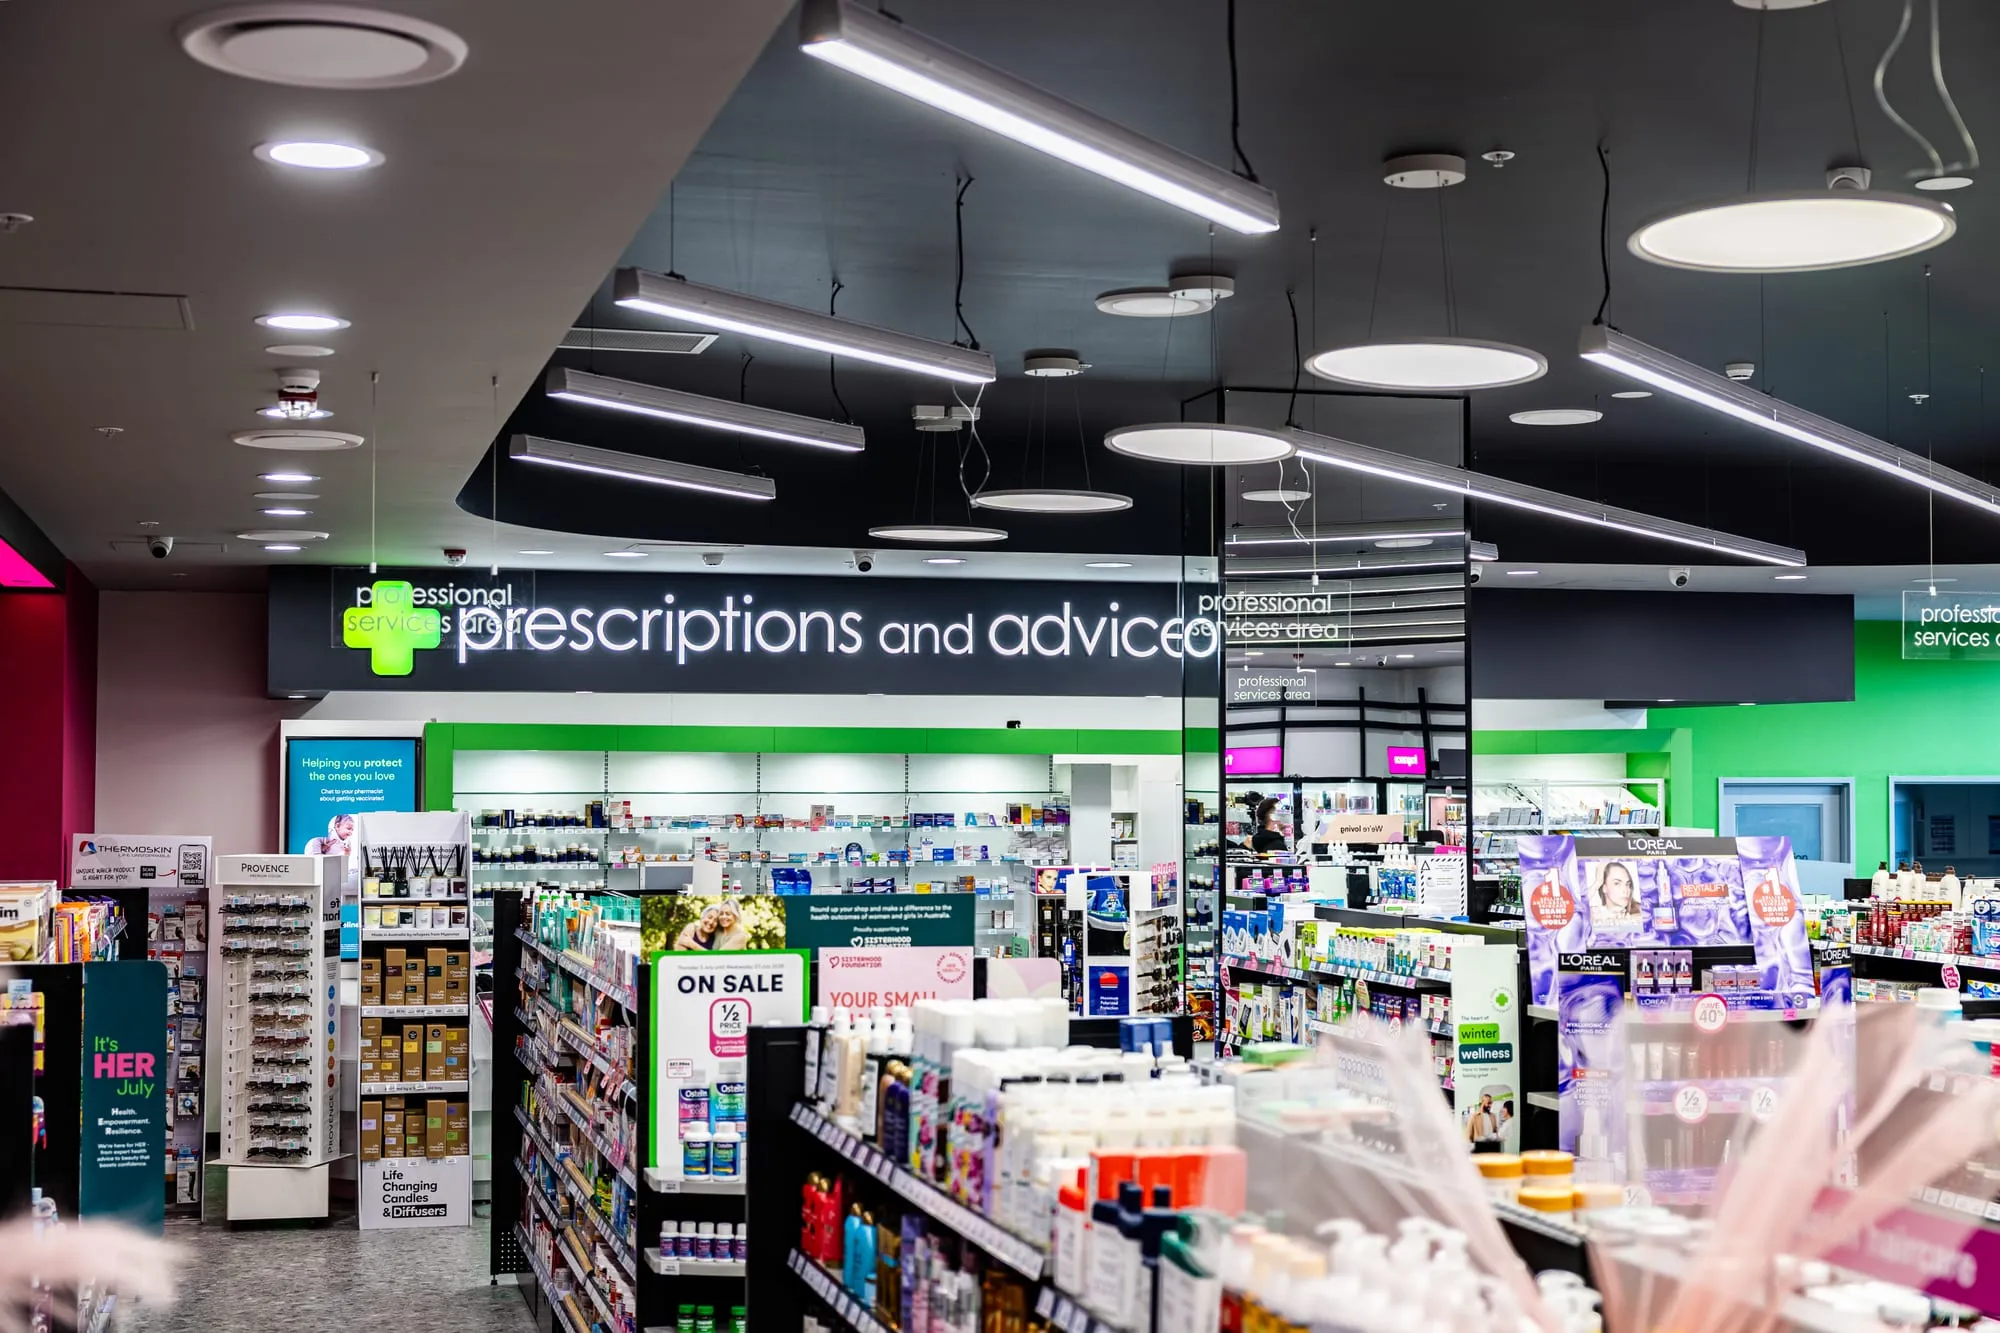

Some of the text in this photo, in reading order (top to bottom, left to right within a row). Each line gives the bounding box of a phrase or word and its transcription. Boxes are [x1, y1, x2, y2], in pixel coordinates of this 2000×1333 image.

[356, 581, 512, 607] professional
[1198, 590, 1332, 616] professional
[347, 611, 451, 633] services
[458, 594, 863, 665] prescriptions
[879, 613, 974, 655] and
[1191, 619, 1340, 639] services area
[1914, 627, 1990, 647] services
[1238, 674, 1307, 689] professional
[1234, 687, 1311, 701] services area
[302, 758, 402, 769] Helping you protect
[309, 772, 325, 781] the
[354, 774, 372, 782] you
[374, 772, 395, 781] love
[354, 788, 384, 796] pharmacist
[97, 845, 172, 854] THERMOSKIN
[1627, 837, 1683, 850] L'ORÉAL
[241, 863, 290, 873] PROVENCE
[810, 905, 830, 913] Round
[854, 905, 869, 913] shop
[903, 904, 934, 912] difference
[903, 912, 916, 920] girls
[1561, 953, 1621, 966] L'ORÉAL
[677, 974, 784, 994] ON SALE
[830, 991, 878, 1008] YOUR
[1461, 1028, 1497, 1039] winter
[94, 1036, 119, 1052] It's
[1461, 1047, 1510, 1060] wellness
[94, 1052, 156, 1079] HER
[116, 1079, 155, 1099] July
[685, 1090, 708, 1098] Ostelin
[383, 1170, 404, 1180] Life
[382, 1180, 438, 1193] Changing
[382, 1193, 429, 1204] Candles
[382, 1206, 446, 1217] & Diffusers
